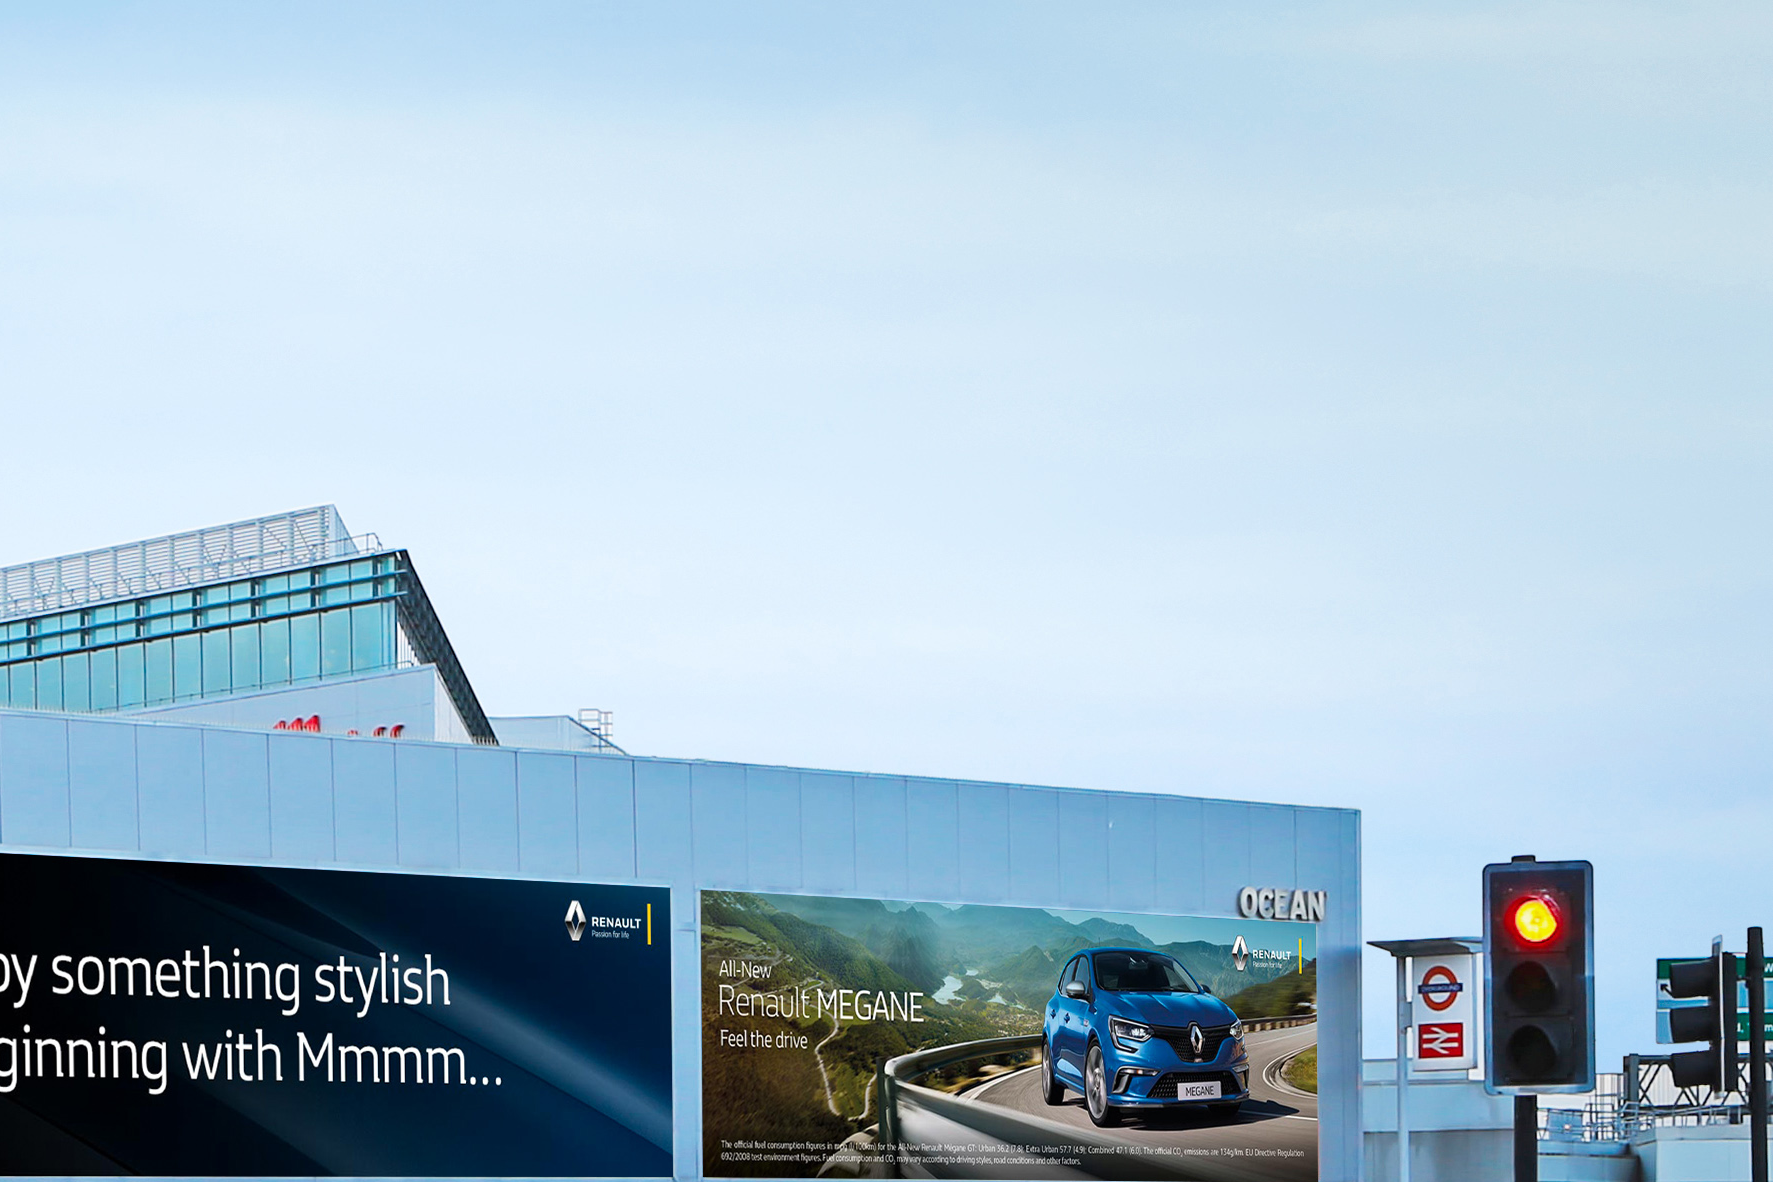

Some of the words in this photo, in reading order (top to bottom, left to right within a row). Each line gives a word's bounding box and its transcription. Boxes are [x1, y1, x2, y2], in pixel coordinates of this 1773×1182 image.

[1239, 886, 1326, 921] OCEAN
[591, 917, 642, 929] RENAULT
[591, 930, 613, 938] Passion
[613, 931, 621, 939] for
[621, 931, 630, 940] life
[1252, 950, 1291, 961] RENAULT
[719, 960, 772, 978] All-New
[1253, 961, 1269, 969] Passion
[51, 946, 300, 1017] something
[314, 952, 451, 1019] stylish
[719, 984, 810, 1018] Renault
[817, 989, 924, 1022] MEGANE
[720, 1029, 747, 1047] Feel
[750, 1030, 772, 1048] the
[775, 1031, 808, 1050] drive
[181, 1029, 284, 1082] with
[296, 1032, 502, 1086] Mmmm...
[1185, 1086, 1215, 1097] MEGANE
[721, 1140, 732, 1149] The
[734, 1140, 753, 1150] official
[755, 1140, 766, 1150] fuel
[767, 1141, 804, 1153] consumption
[805, 1141, 826, 1153] figures
[827, 1141, 833, 1150] in
[887, 1143, 897, 1152] the
[897, 1143, 920, 1152] All-New
[921, 1143, 942, 1153] Renault
[978, 1144, 996, 1153] Urban
[997, 1144, 1009, 1153] 36.2
[1025, 1145, 1040, 1153] Extra
[1041, 1145, 1059, 1153] Urban
[1059, 1146, 1072, 1154] 57.7
[1087, 1146, 1114, 1154] Combined
[1116, 1147, 1128, 1155] 47.1
[1143, 1147, 1154, 1155] The
[1155, 1147, 1172, 1155] official
[1184, 1148, 1210, 1156] emissions
[1255, 1149, 1276, 1157] Directive
[1277, 1149, 1305, 1159] Regulation
[721, 1152, 750, 1161] 692/2008
[751, 1153, 762, 1161] test
[763, 1153, 800, 1161] environment
[801, 1153, 821, 1164] figures.
[822, 1154, 835, 1162] Fuel
[835, 1154, 874, 1164] consumption
[874, 1154, 884, 1163] and
[897, 1156, 909, 1165] may
[909, 1157, 921, 1165] vary
[922, 1156, 949, 1165] according
[949, 1156, 956, 1164] to
[957, 1156, 975, 1166] driving
[976, 1156, 993, 1166] styles,
[993, 1157, 1006, 1165] road
[1007, 1156, 1034, 1165] conditions
[1035, 1157, 1046, 1165] and
[1046, 1157, 1061, 1165] other
[1061, 1157, 1081, 1166] factors.
